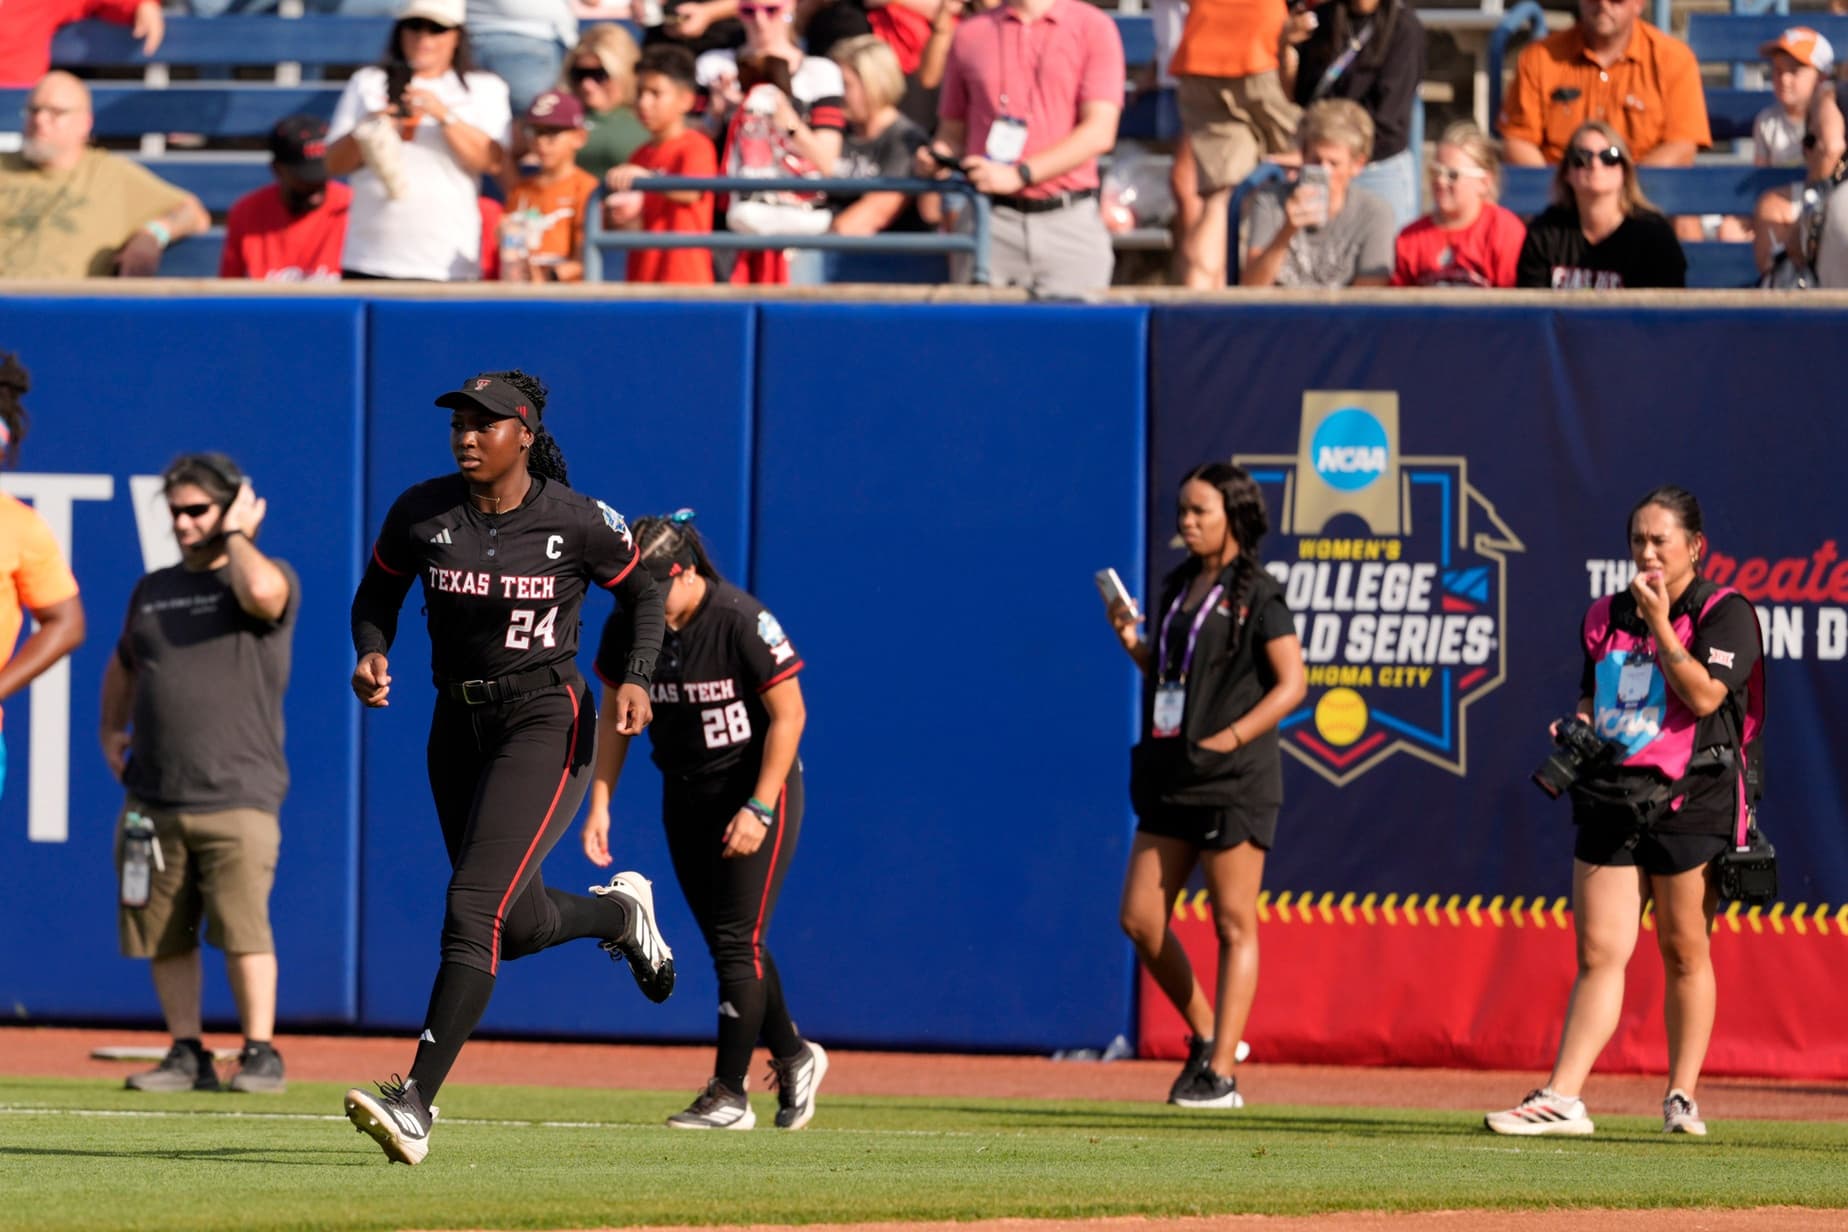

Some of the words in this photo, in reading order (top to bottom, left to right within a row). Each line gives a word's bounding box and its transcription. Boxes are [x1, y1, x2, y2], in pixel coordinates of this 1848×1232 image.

[1316, 445, 1388, 474] NCAA
[545, 534, 565, 560] C
[1299, 538, 1402, 560] WOMEN'S
[428, 565, 491, 597] TEXAS
[500, 575, 556, 600] TECH
[1585, 558, 1639, 600] TH
[1699, 535, 1848, 604] reate
[504, 606, 560, 651] 24
[1344, 613, 1496, 665] SERIES
[1816, 605, 1848, 661] D
[683, 678, 735, 704] TECH
[1378, 666, 1433, 688] CITY
[700, 699, 752, 749] 28
